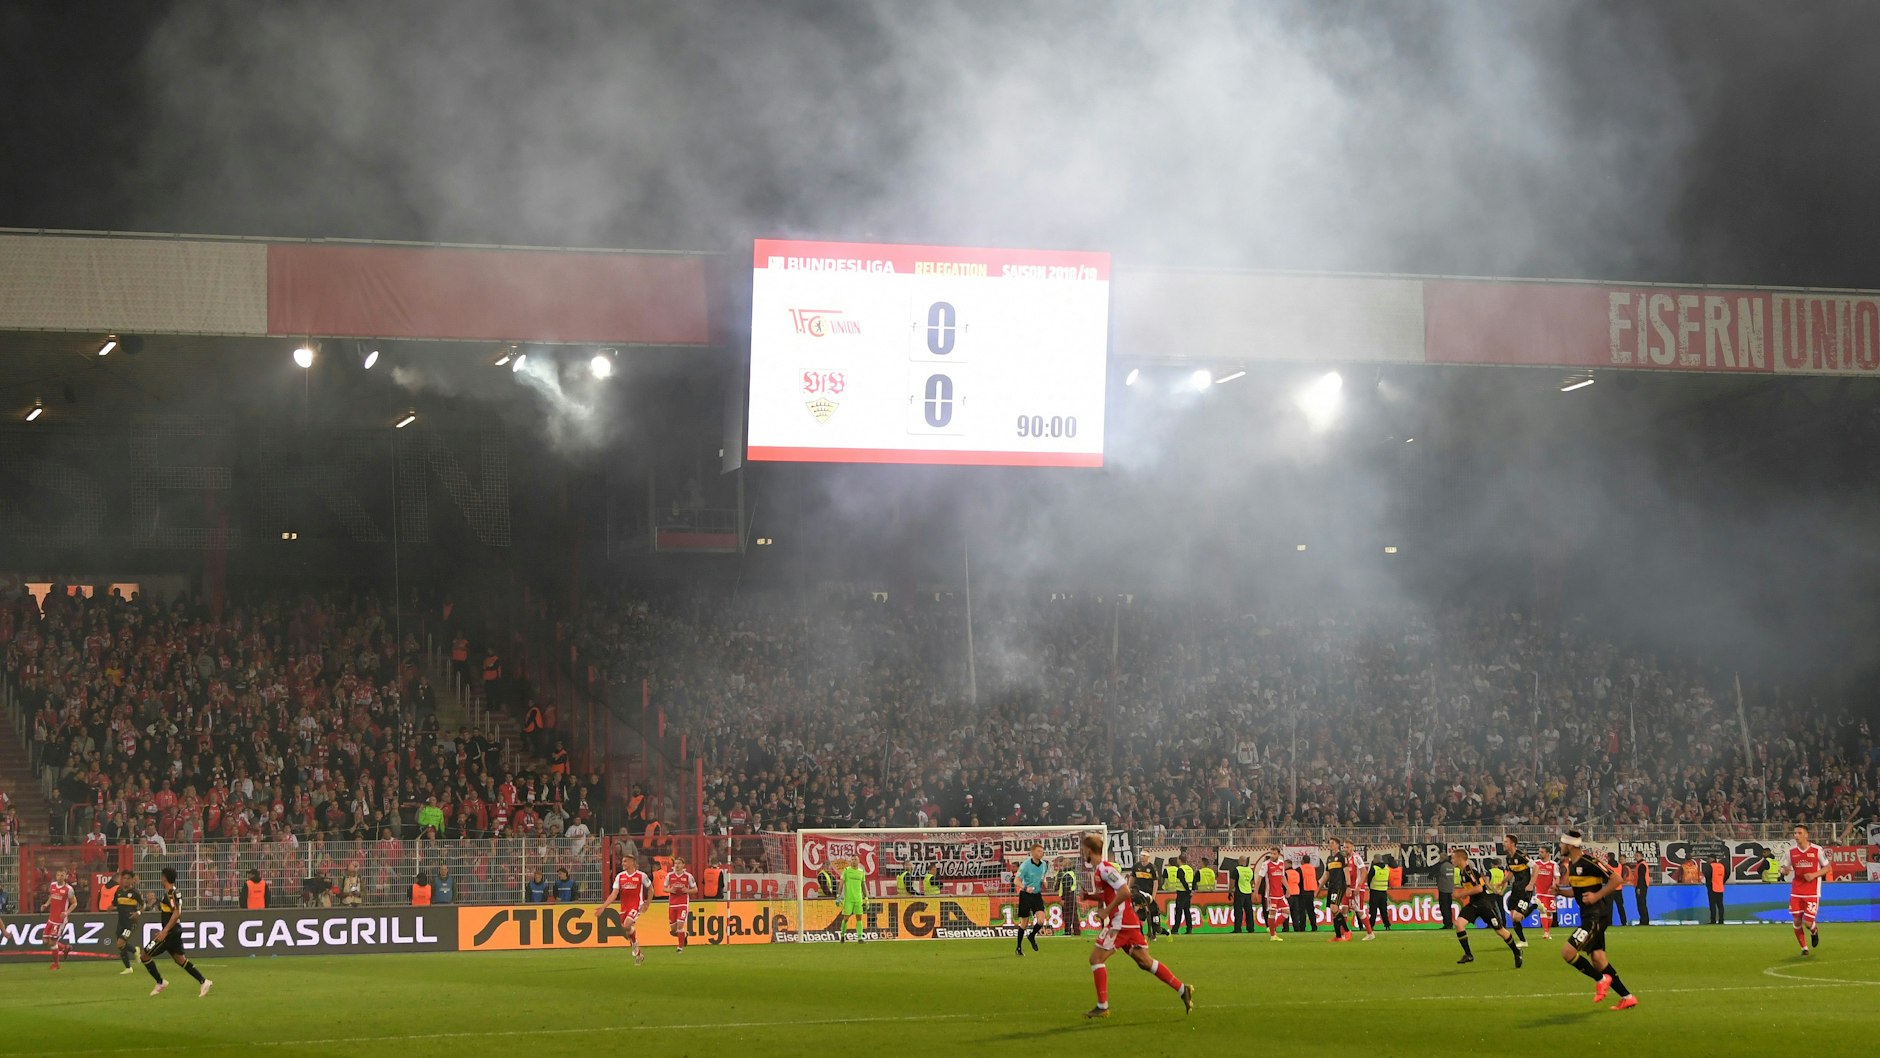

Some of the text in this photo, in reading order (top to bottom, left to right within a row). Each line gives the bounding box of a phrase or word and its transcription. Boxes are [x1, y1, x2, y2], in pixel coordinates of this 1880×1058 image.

[787, 257, 895, 274] BUNDESLIGA
[914, 261, 988, 277] RELEGATION
[1002, 264, 1098, 282] SAISON 2018/19
[830, 320, 861, 334] UNION
[927, 302, 956, 355] 0
[1608, 291, 1765, 369] EISERN
[925, 374, 953, 428] 0
[1017, 415, 1077, 439] 90:00
[1620, 842, 1657, 852] ULTRAS
[1833, 851, 1857, 863] MTS
[1517, 899, 1529, 910] 20
[1806, 901, 1818, 913] 32
[238, 916, 438, 948] GASGRILL
[474, 907, 630, 947] STIGA
[670, 907, 788, 945] tiga.de
[936, 927, 997, 939] Eisenbach
[775, 931, 835, 943] Eisenbach
[1572, 927, 1589, 943] 18
